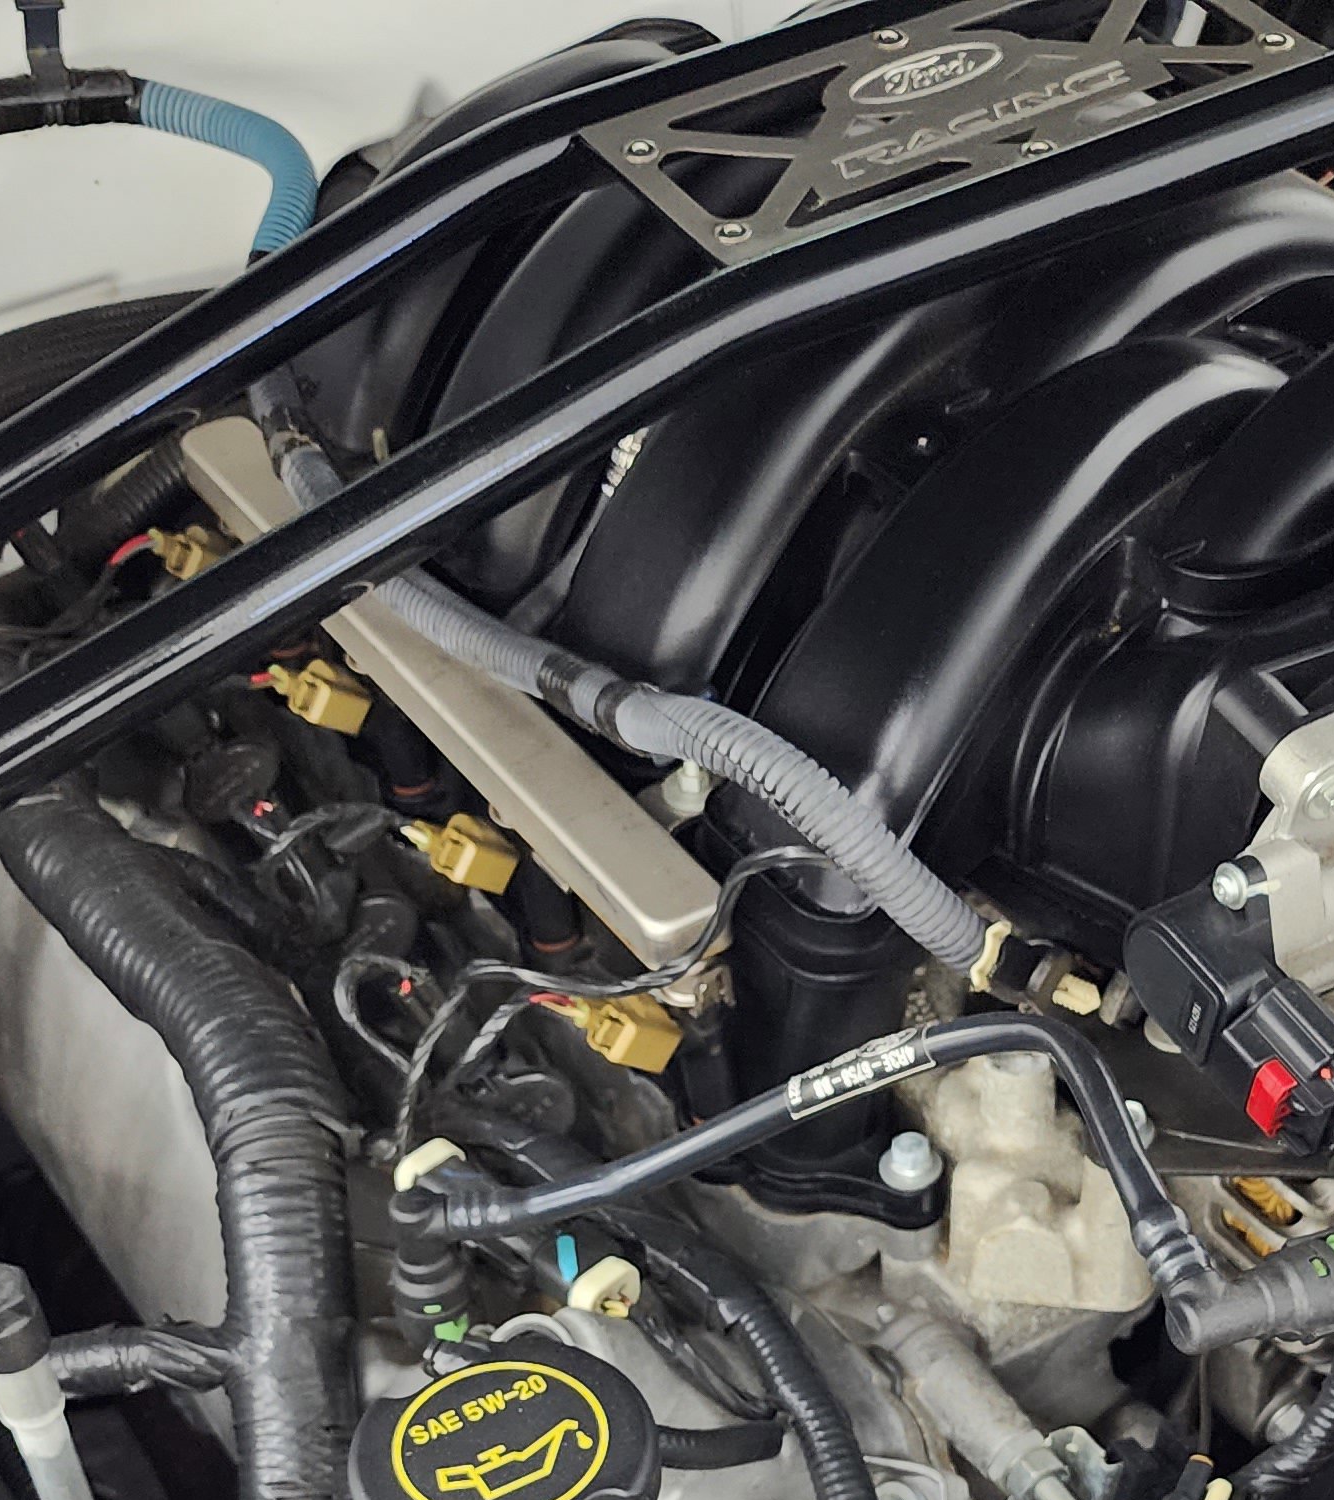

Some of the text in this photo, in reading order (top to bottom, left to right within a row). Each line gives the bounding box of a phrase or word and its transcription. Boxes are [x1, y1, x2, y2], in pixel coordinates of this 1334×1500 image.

[832, 59, 1131, 179] RACING
[408, 1374, 549, 1447] SAE 5W-20
